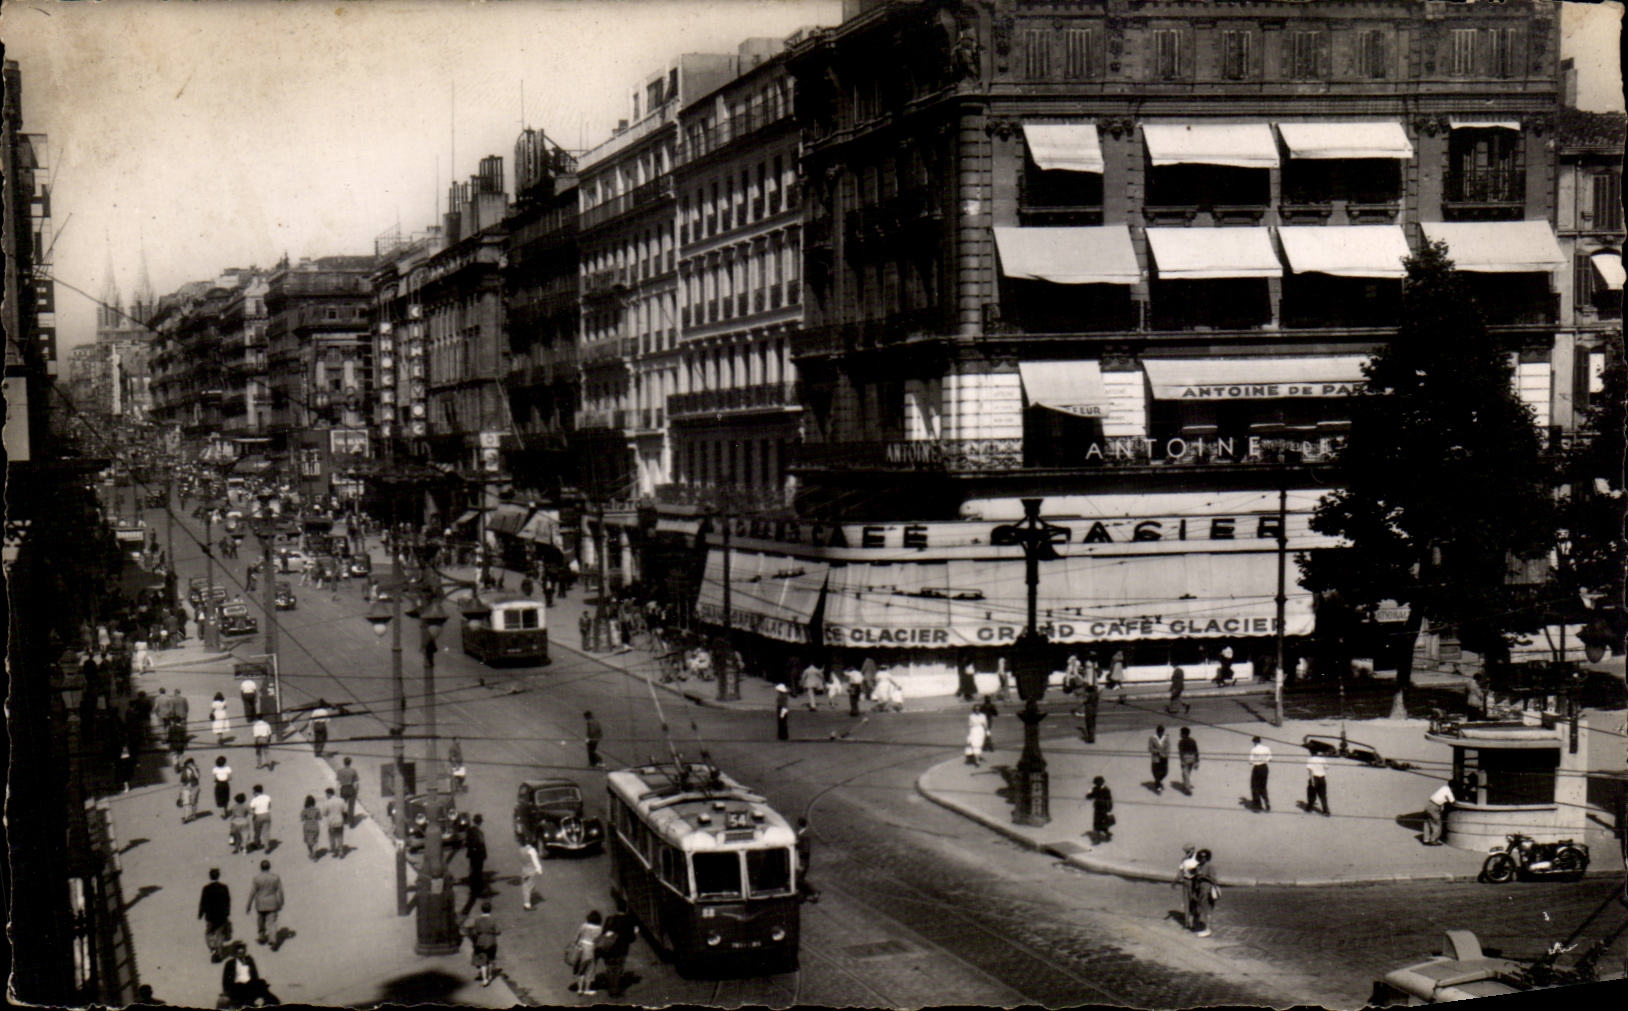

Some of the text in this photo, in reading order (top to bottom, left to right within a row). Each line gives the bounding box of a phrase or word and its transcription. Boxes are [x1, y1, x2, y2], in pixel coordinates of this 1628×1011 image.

[1182, 386, 1279, 398] ANTOINE
[1289, 386, 1312, 395] DE
[1085, 436, 1261, 460] ANTOINE
[850, 628, 949, 643] GLACIER
